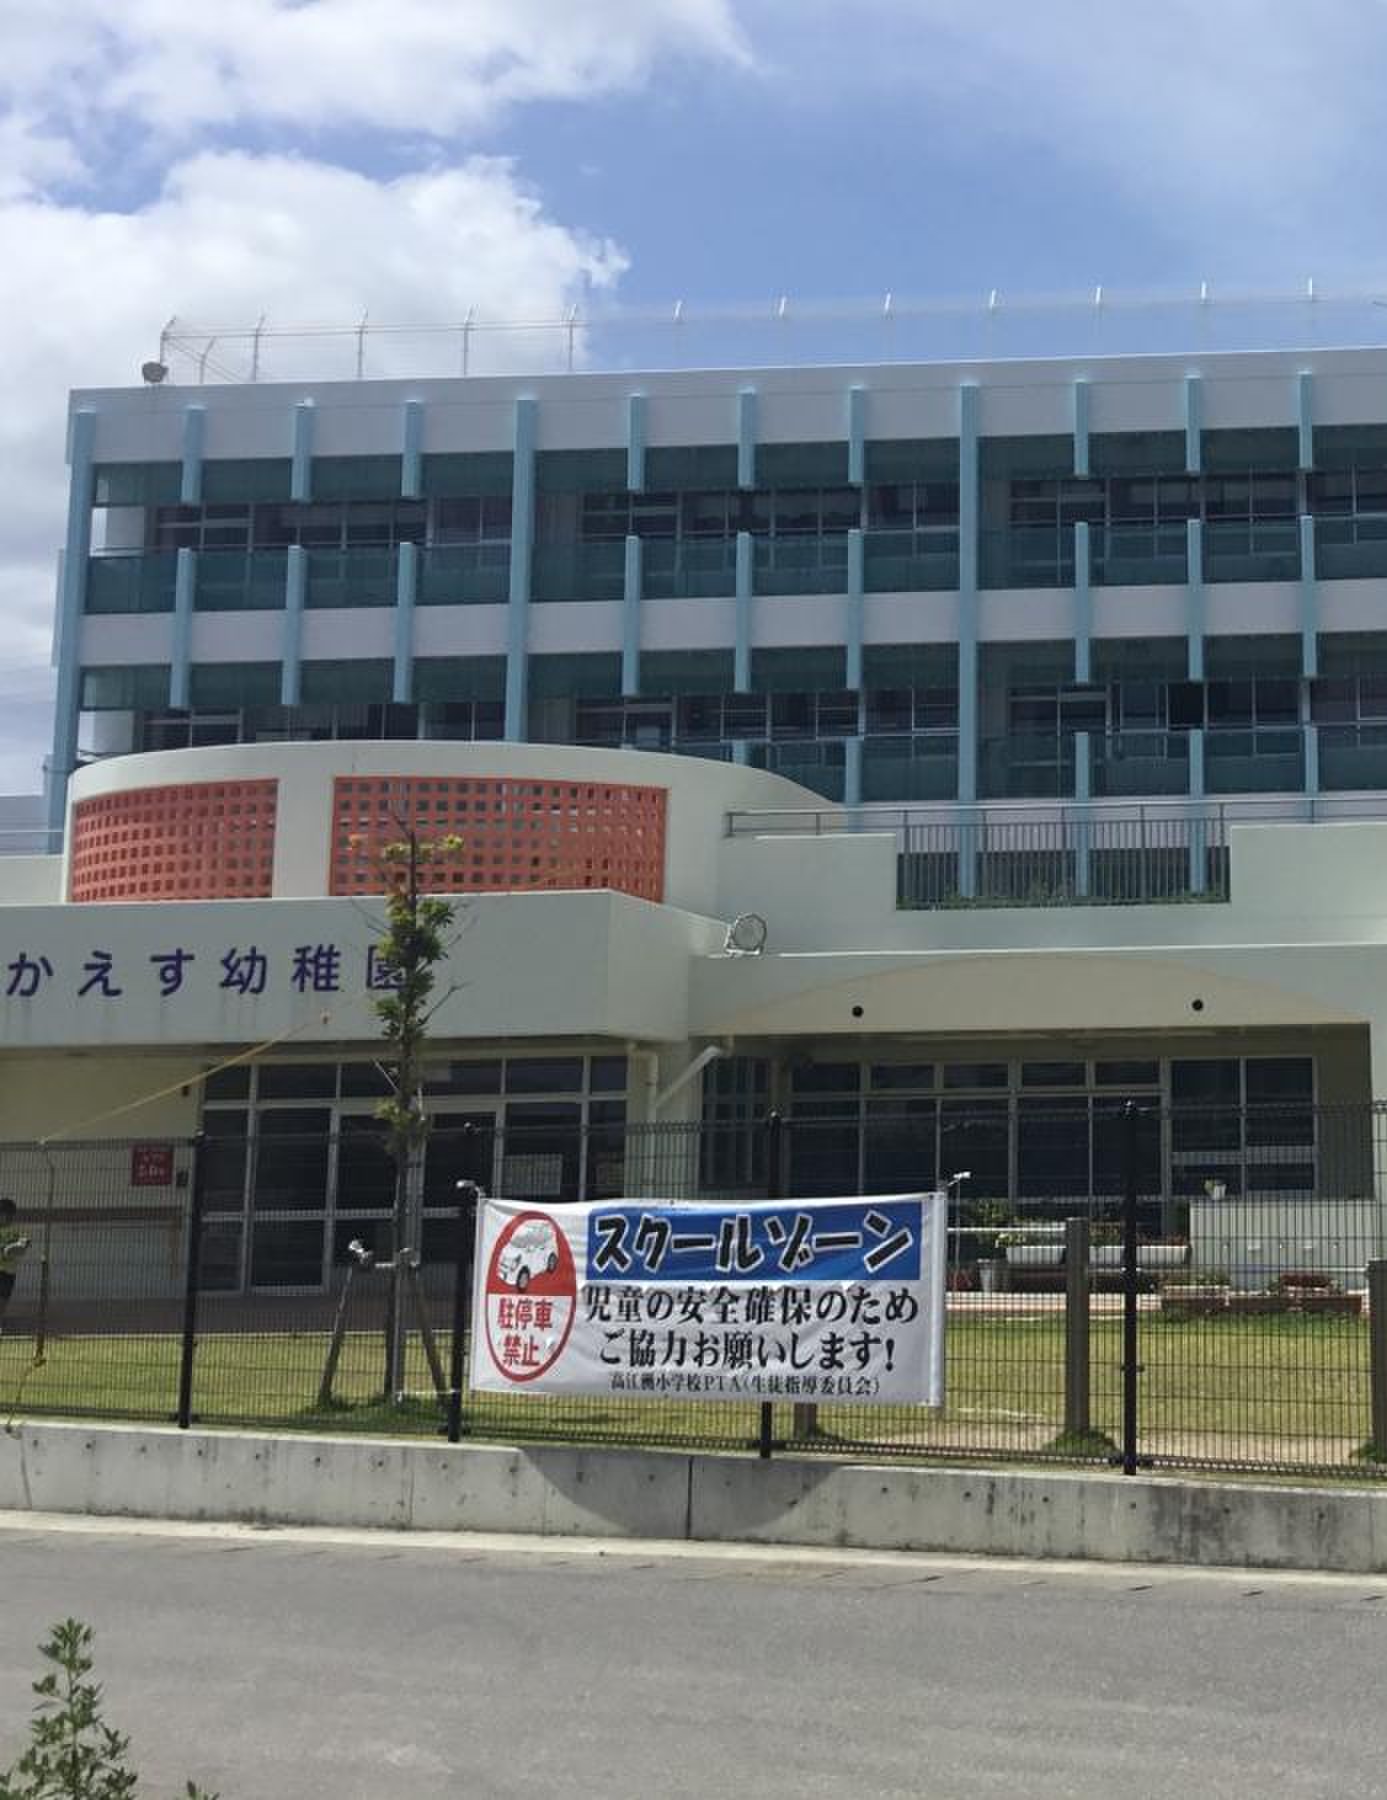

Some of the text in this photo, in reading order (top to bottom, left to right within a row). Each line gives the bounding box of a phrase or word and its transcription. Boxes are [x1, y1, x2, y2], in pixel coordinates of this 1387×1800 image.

[593, 1210, 913, 1273] スクールゾーン
[498, 1297, 553, 1331] 駐停車
[585, 1285, 918, 1324] 児童の安全確保のため
[503, 1334, 540, 1366] 禁止
[599, 1330, 896, 1370] ご協力お願いします!
